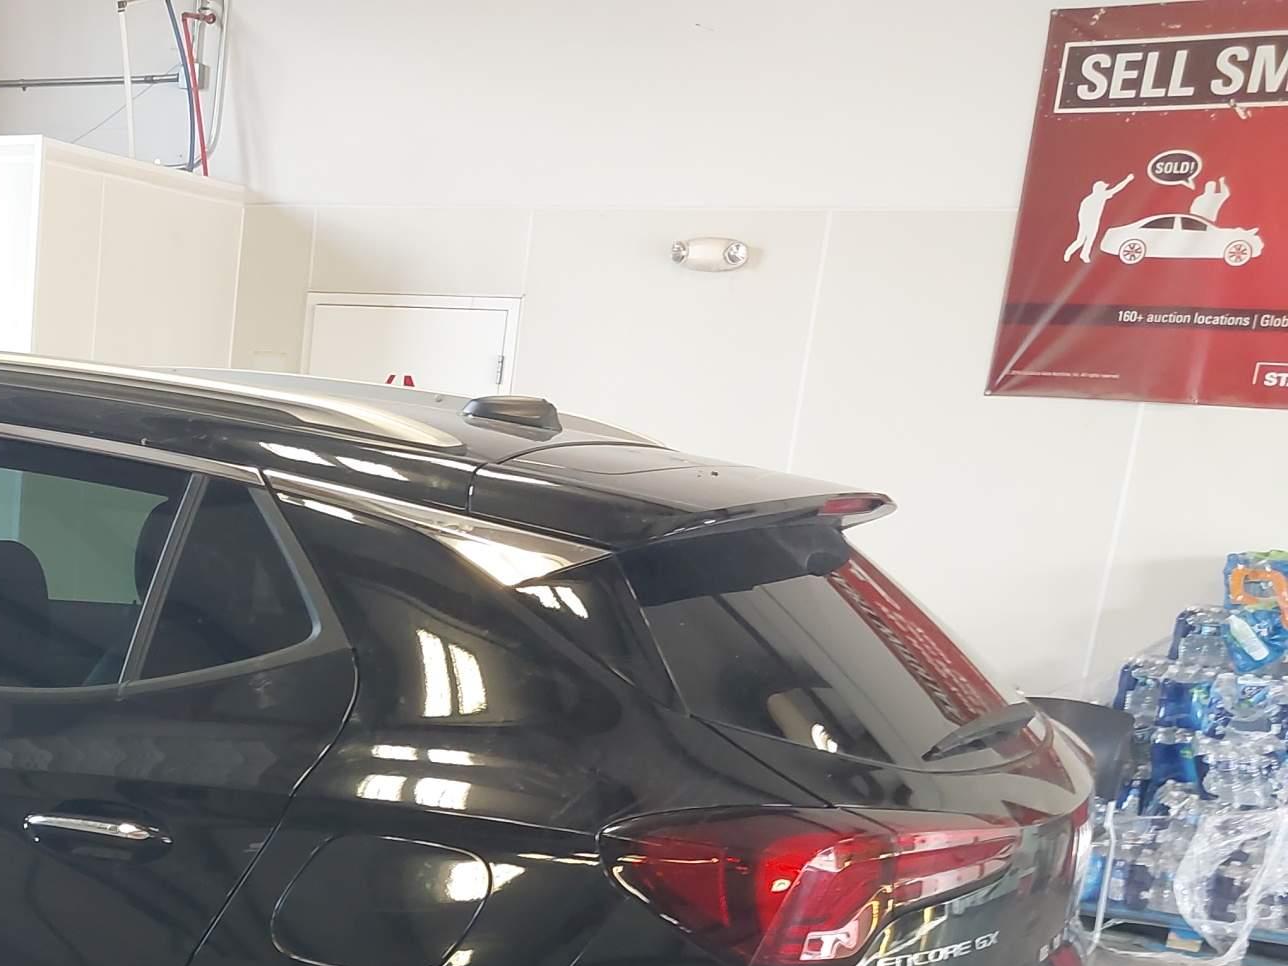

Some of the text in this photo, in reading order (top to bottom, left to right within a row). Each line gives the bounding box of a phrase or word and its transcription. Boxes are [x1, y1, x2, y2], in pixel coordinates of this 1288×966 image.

[1076, 50, 1195, 100] SELL
[1155, 161, 1196, 174] SOLD!
[1117, 311, 1144, 323] 160+
[1146, 312, 1191, 324] auction
[1193, 312, 1250, 326] locations
[1263, 371, 1288, 387] ST
[974, 930, 1000, 950] GX
